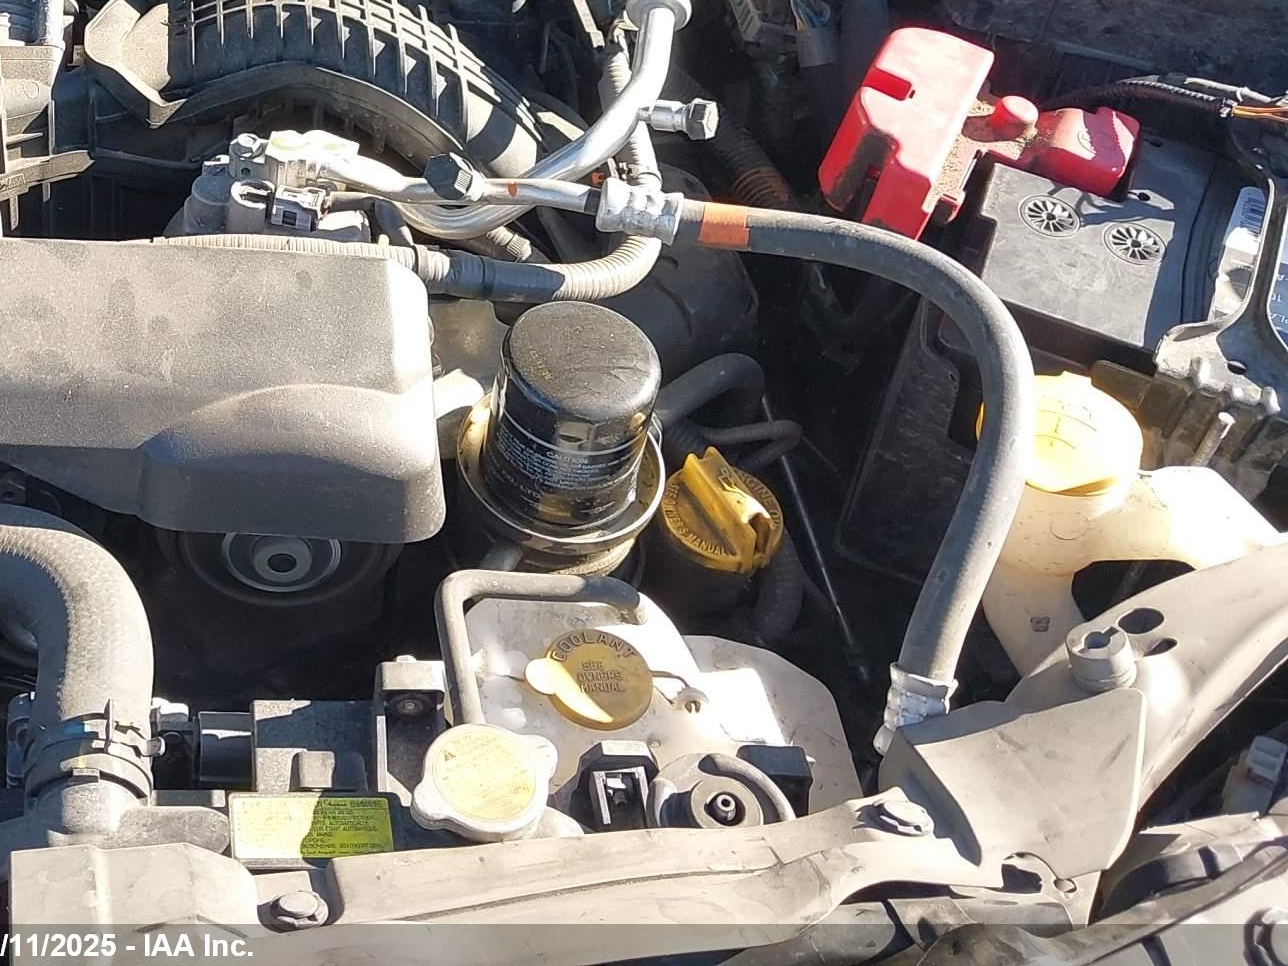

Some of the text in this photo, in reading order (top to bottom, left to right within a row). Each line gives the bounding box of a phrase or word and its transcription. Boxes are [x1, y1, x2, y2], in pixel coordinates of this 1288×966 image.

[687, 532, 728, 556] MANUAL
[551, 631, 638, 662] COOLANT
[581, 660, 604, 671] SEE
[579, 681, 626, 694] MANUAL
